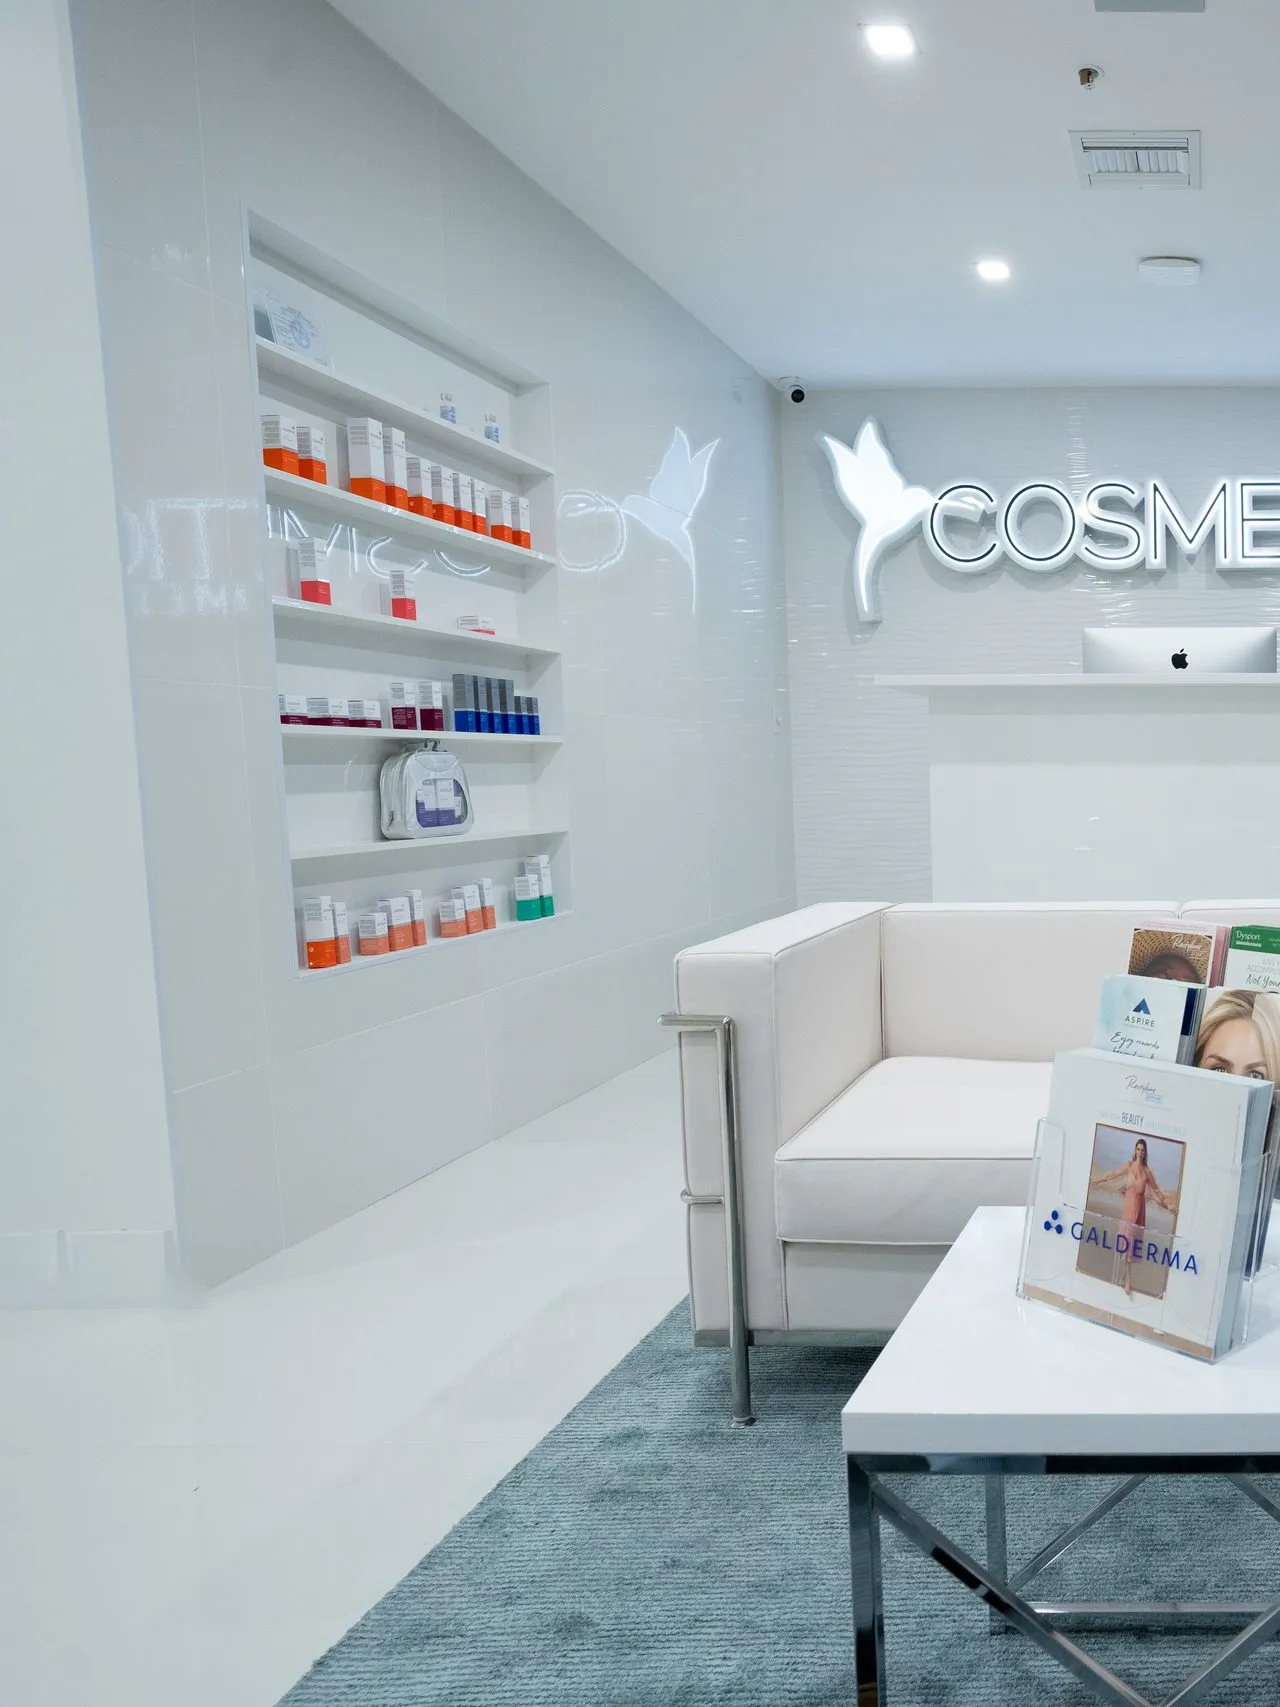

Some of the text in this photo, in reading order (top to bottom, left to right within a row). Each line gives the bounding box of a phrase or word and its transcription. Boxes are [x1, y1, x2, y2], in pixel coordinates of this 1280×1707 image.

[1235, 930, 1261, 941] Dysport
[1245, 973, 1260, 985] Not
[1261, 975, 1280, 989] Your
[1125, 1015, 1156, 1028] ASPIRE
[1121, 1112, 1144, 1126] BEAUTY
[1070, 1221, 1198, 1275] GALDERMA
